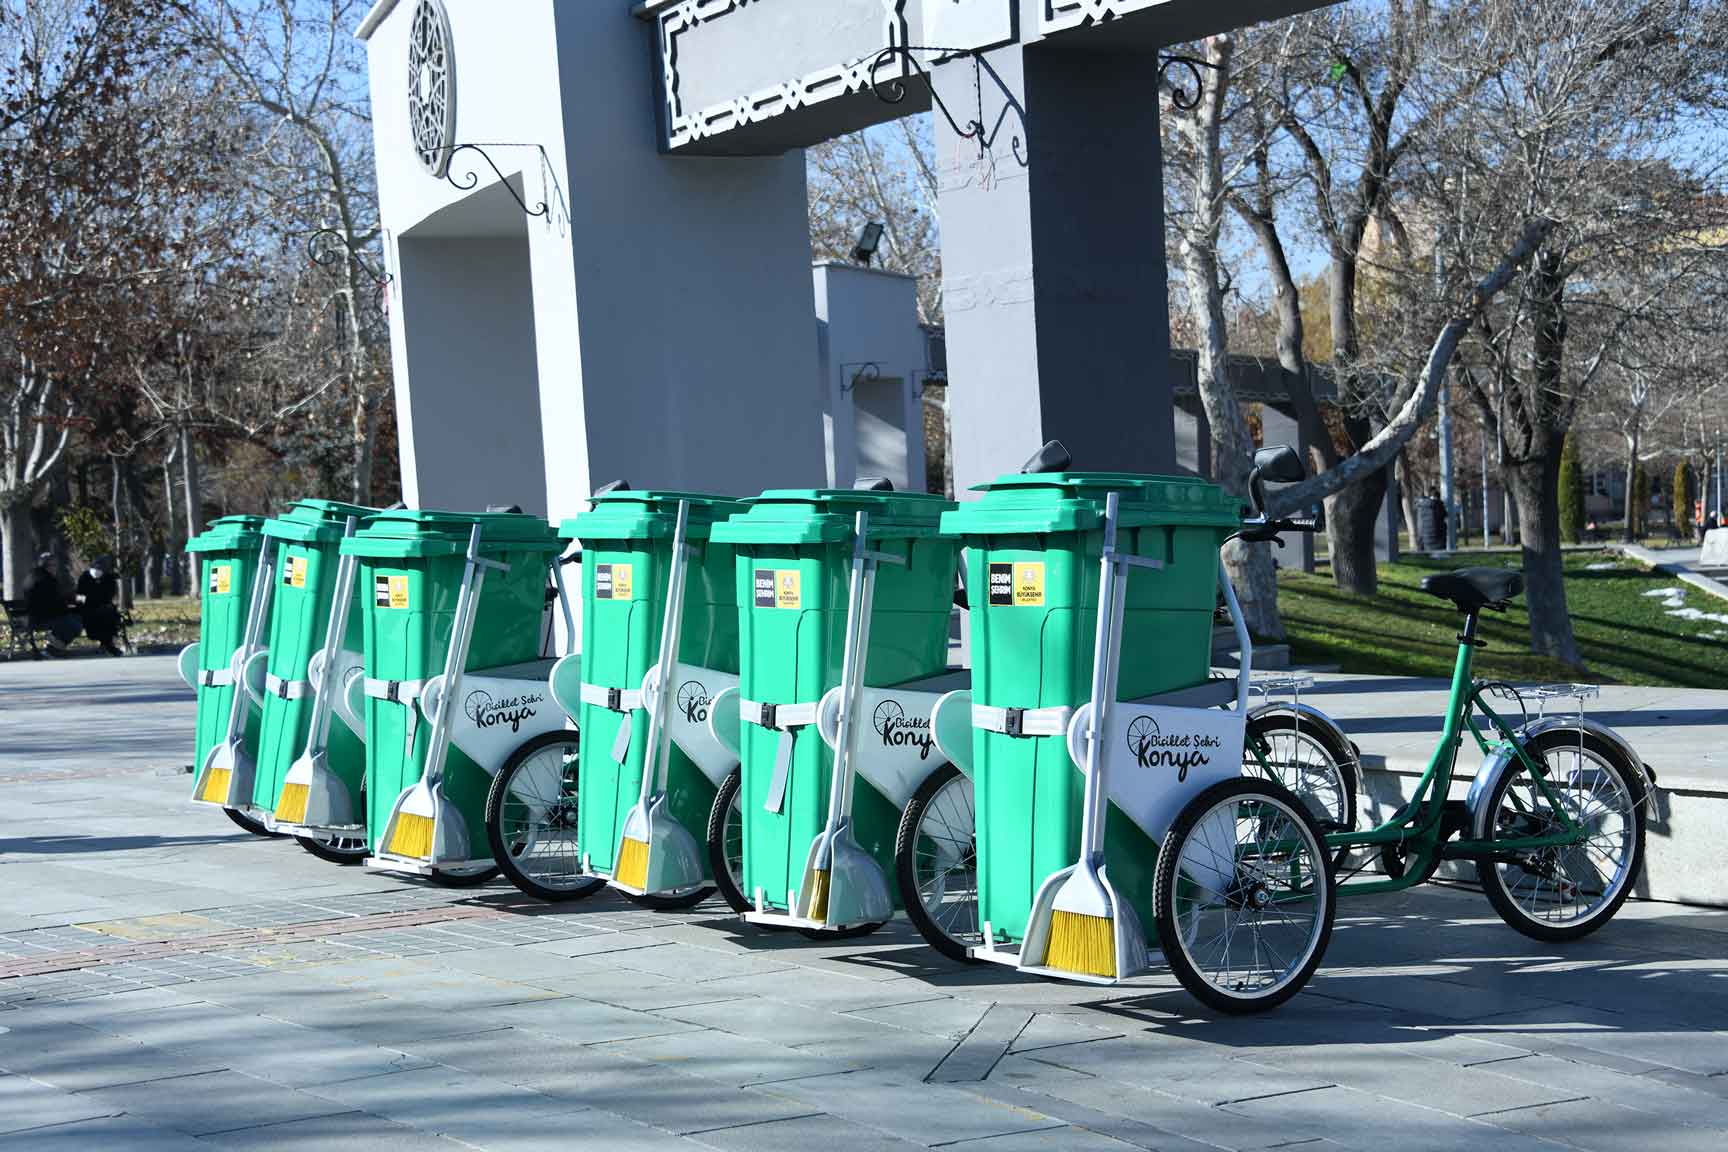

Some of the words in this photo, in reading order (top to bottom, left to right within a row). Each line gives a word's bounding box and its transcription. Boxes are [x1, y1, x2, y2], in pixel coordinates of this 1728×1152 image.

[476, 705, 537, 733] Konya
[883, 720, 936, 761] Kony
[1138, 738, 1210, 783] Konya
